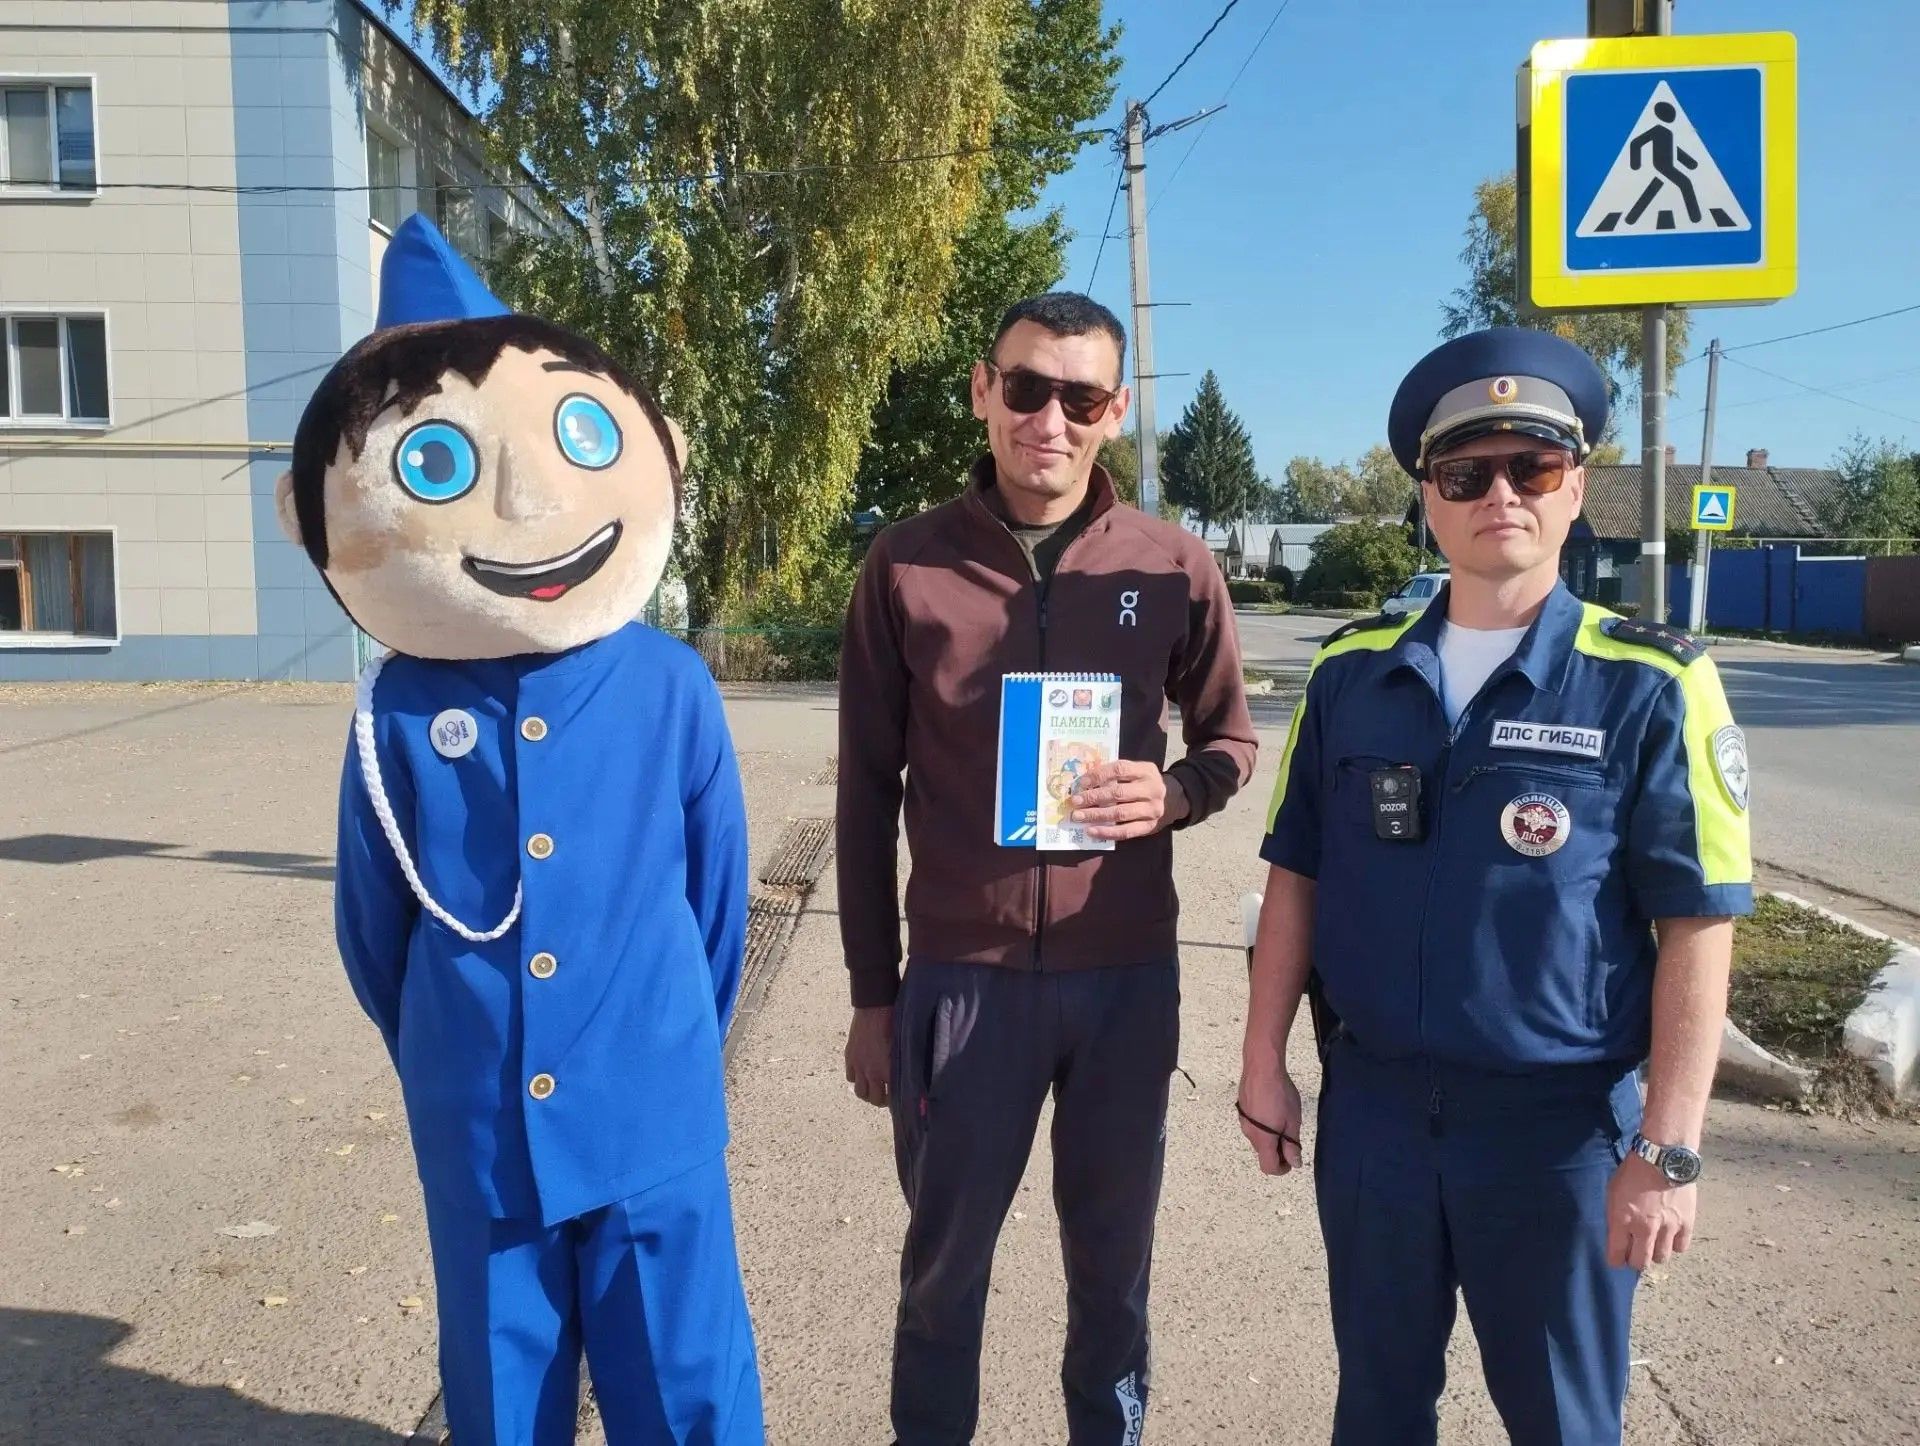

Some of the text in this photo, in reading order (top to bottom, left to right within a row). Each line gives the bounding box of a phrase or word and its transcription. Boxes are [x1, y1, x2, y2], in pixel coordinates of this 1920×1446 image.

[1050, 716, 1110, 728] ПАМЯТКА
[1496, 726, 1598, 751] ДПС ГИБДД
[1380, 803, 1407, 811] DOZOR
[1514, 795, 1565, 818] ПОЛИЦИЯ
[1521, 831, 1544, 844] ДПС
[1129, 1371, 1138, 1398] adidas
